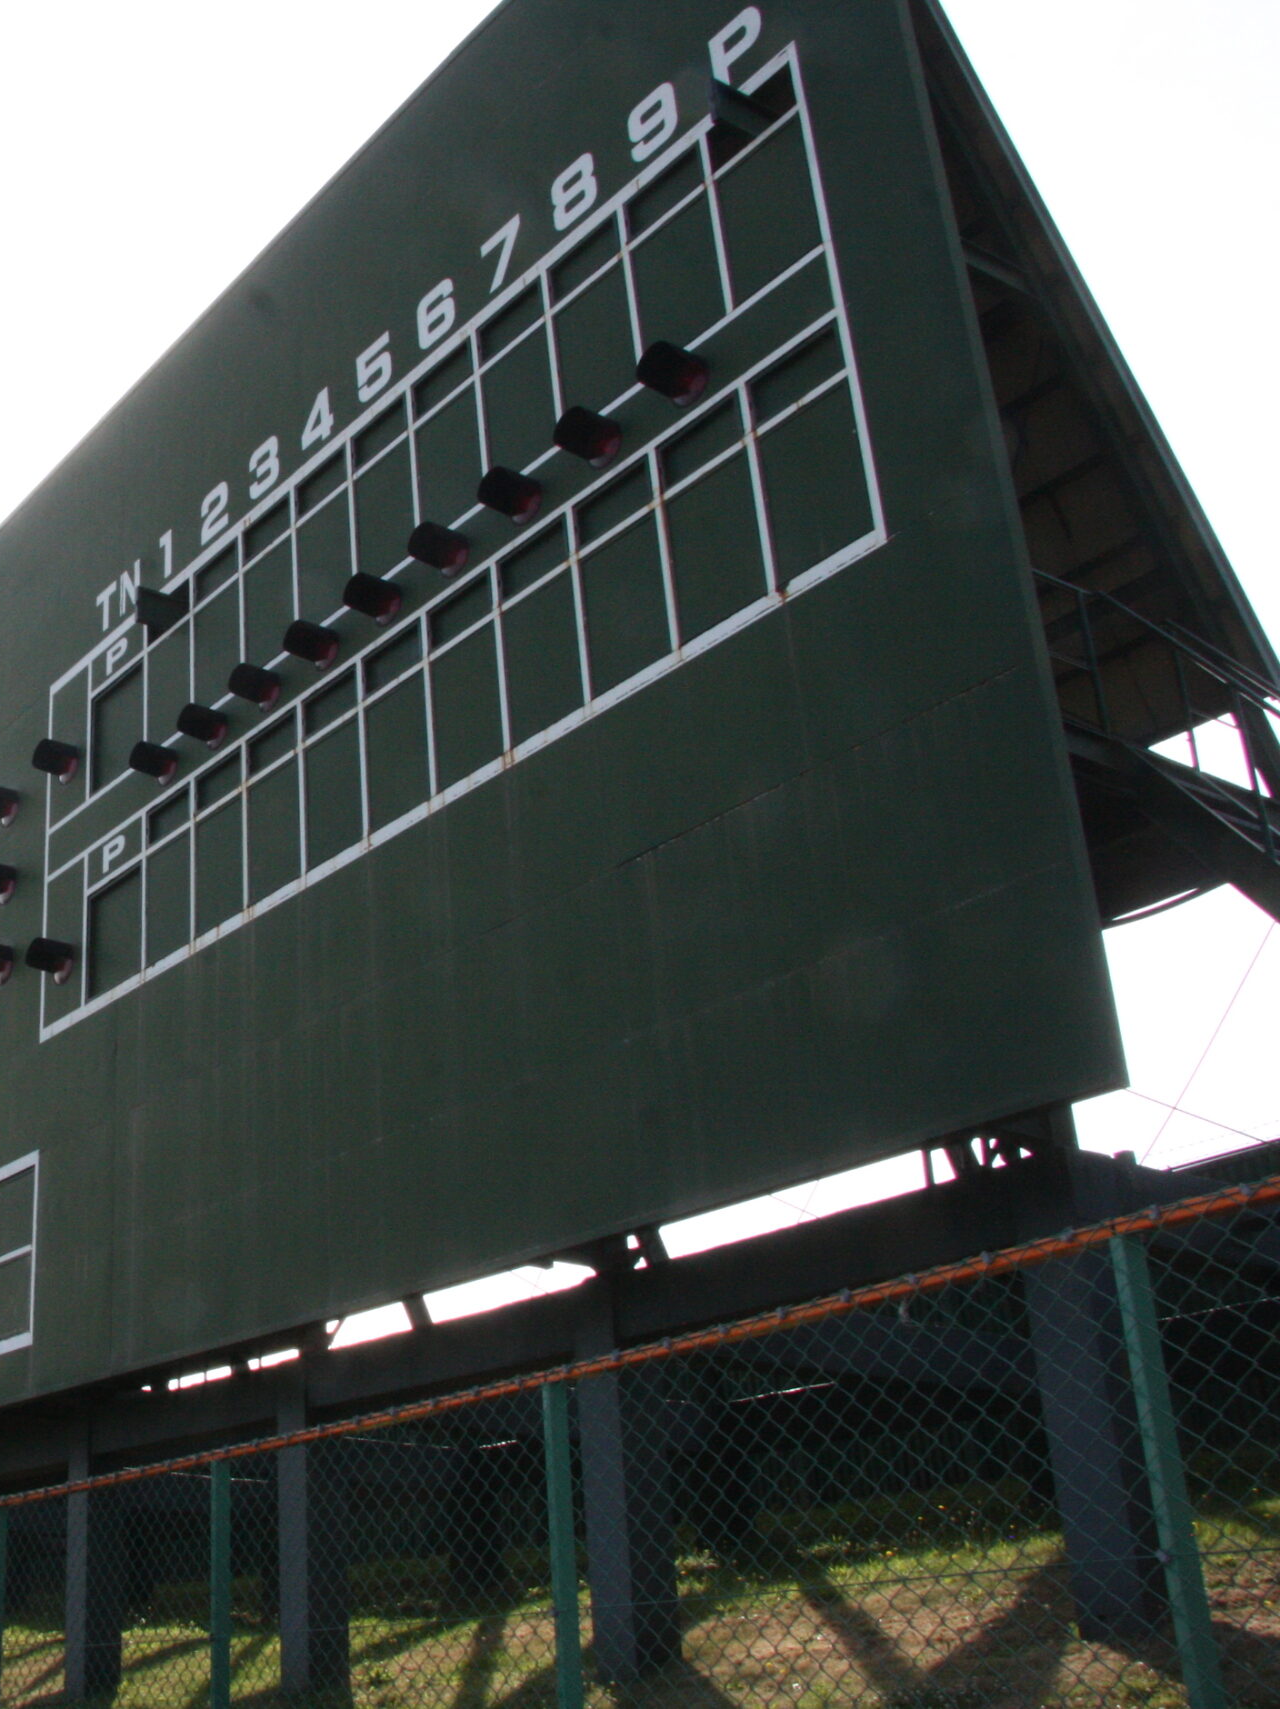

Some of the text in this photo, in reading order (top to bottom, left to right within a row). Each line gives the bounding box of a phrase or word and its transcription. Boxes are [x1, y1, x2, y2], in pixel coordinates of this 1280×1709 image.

[96, 5, 762, 632] TN 1 2 3 4 5 6 7 8 9 P
[106, 637, 128, 676] P
[102, 834, 125, 874] P
